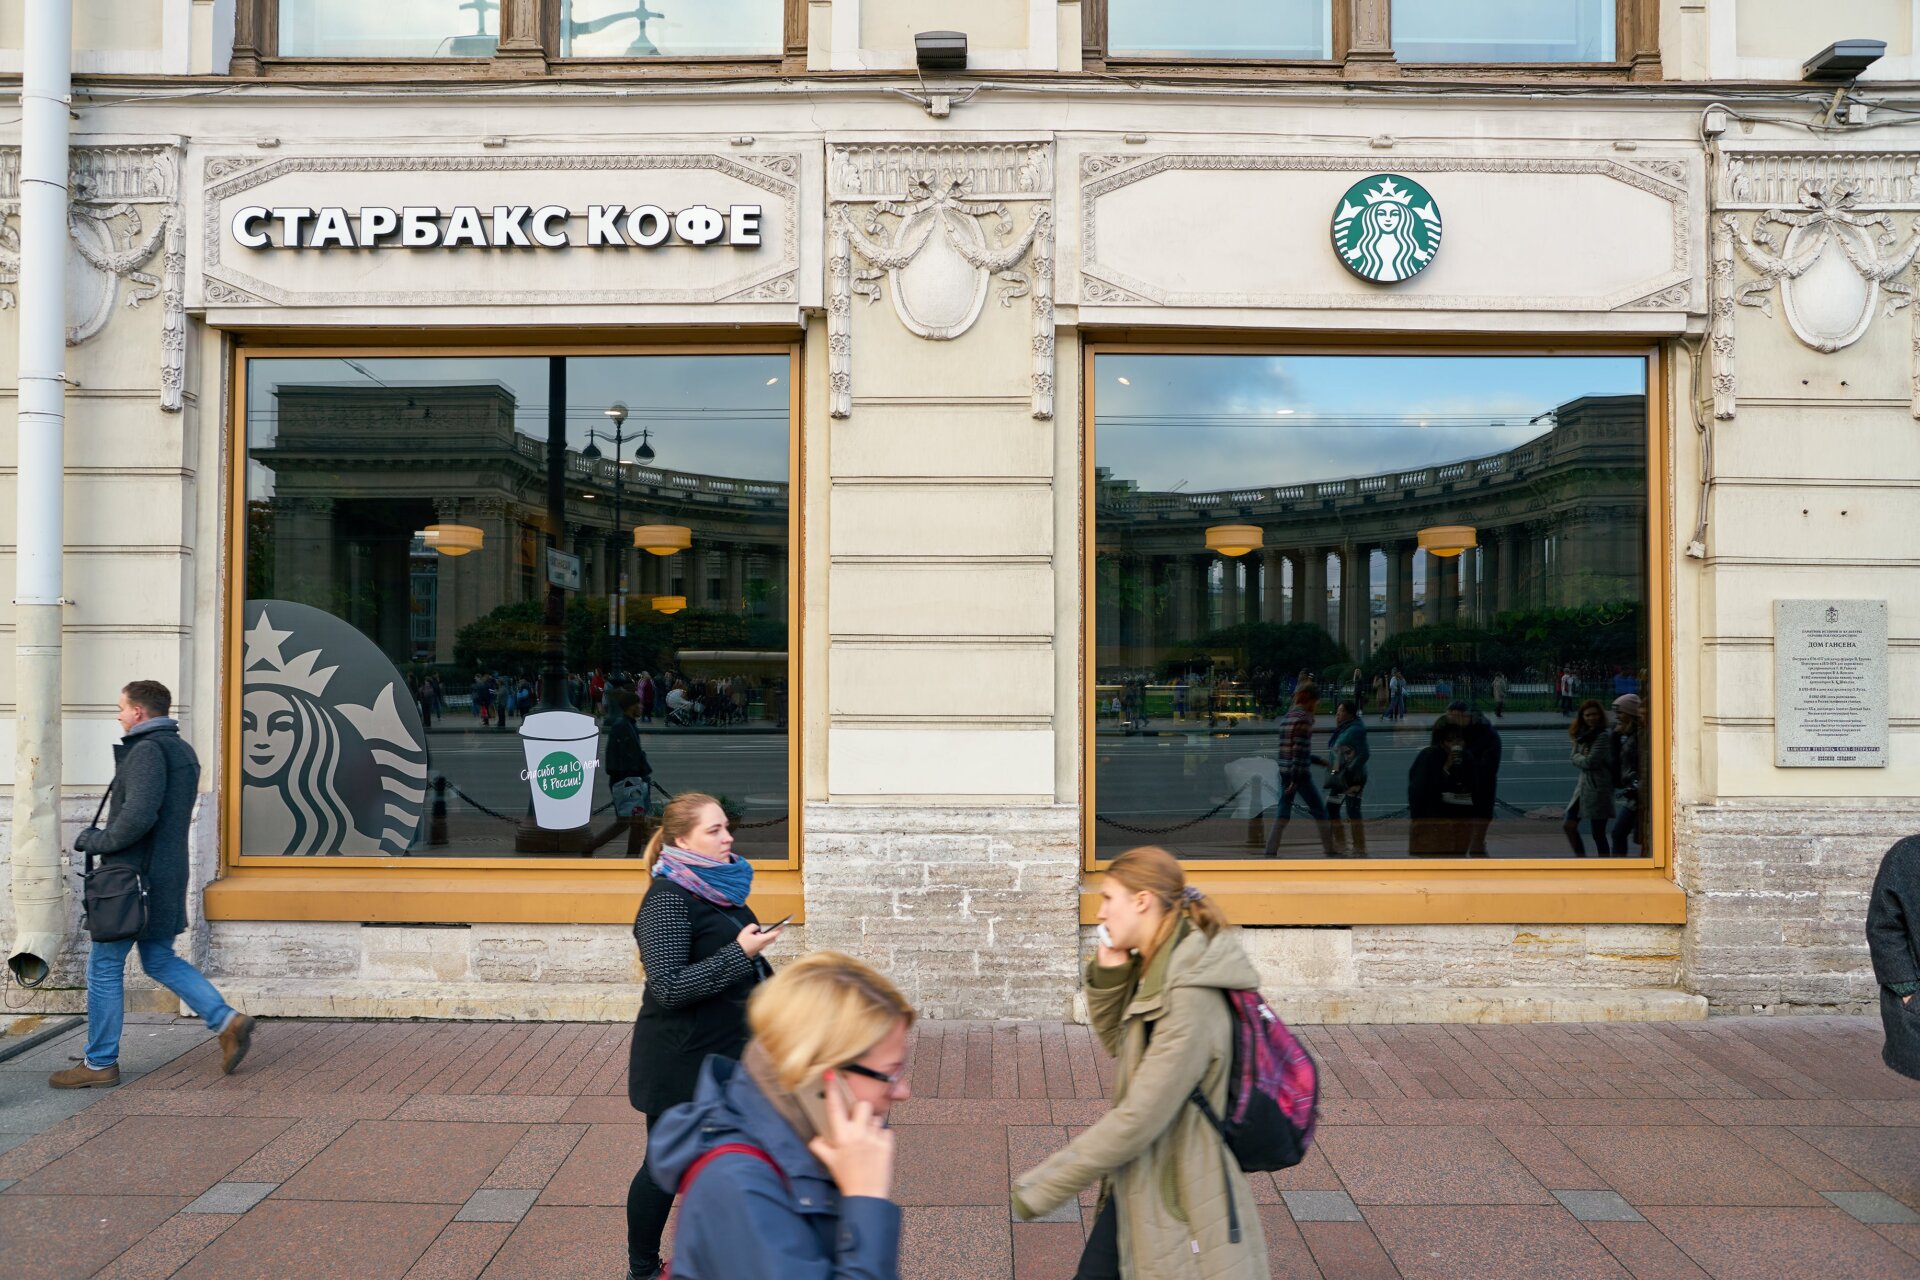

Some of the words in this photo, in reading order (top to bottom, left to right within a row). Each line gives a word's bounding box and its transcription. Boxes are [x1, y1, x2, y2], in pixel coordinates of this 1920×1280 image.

[232, 205, 571, 248] СТАРБАКС
[587, 204, 762, 247] КОФЕ
[1808, 641, 1824, 649] ДОМ
[520, 764, 554, 780] Спасибо
[558, 764, 568, 774] за
[570, 760, 582, 772] 10
[584, 759, 600, 770] лет
[542, 778, 548, 790] в
[550, 772, 580, 790] России!
